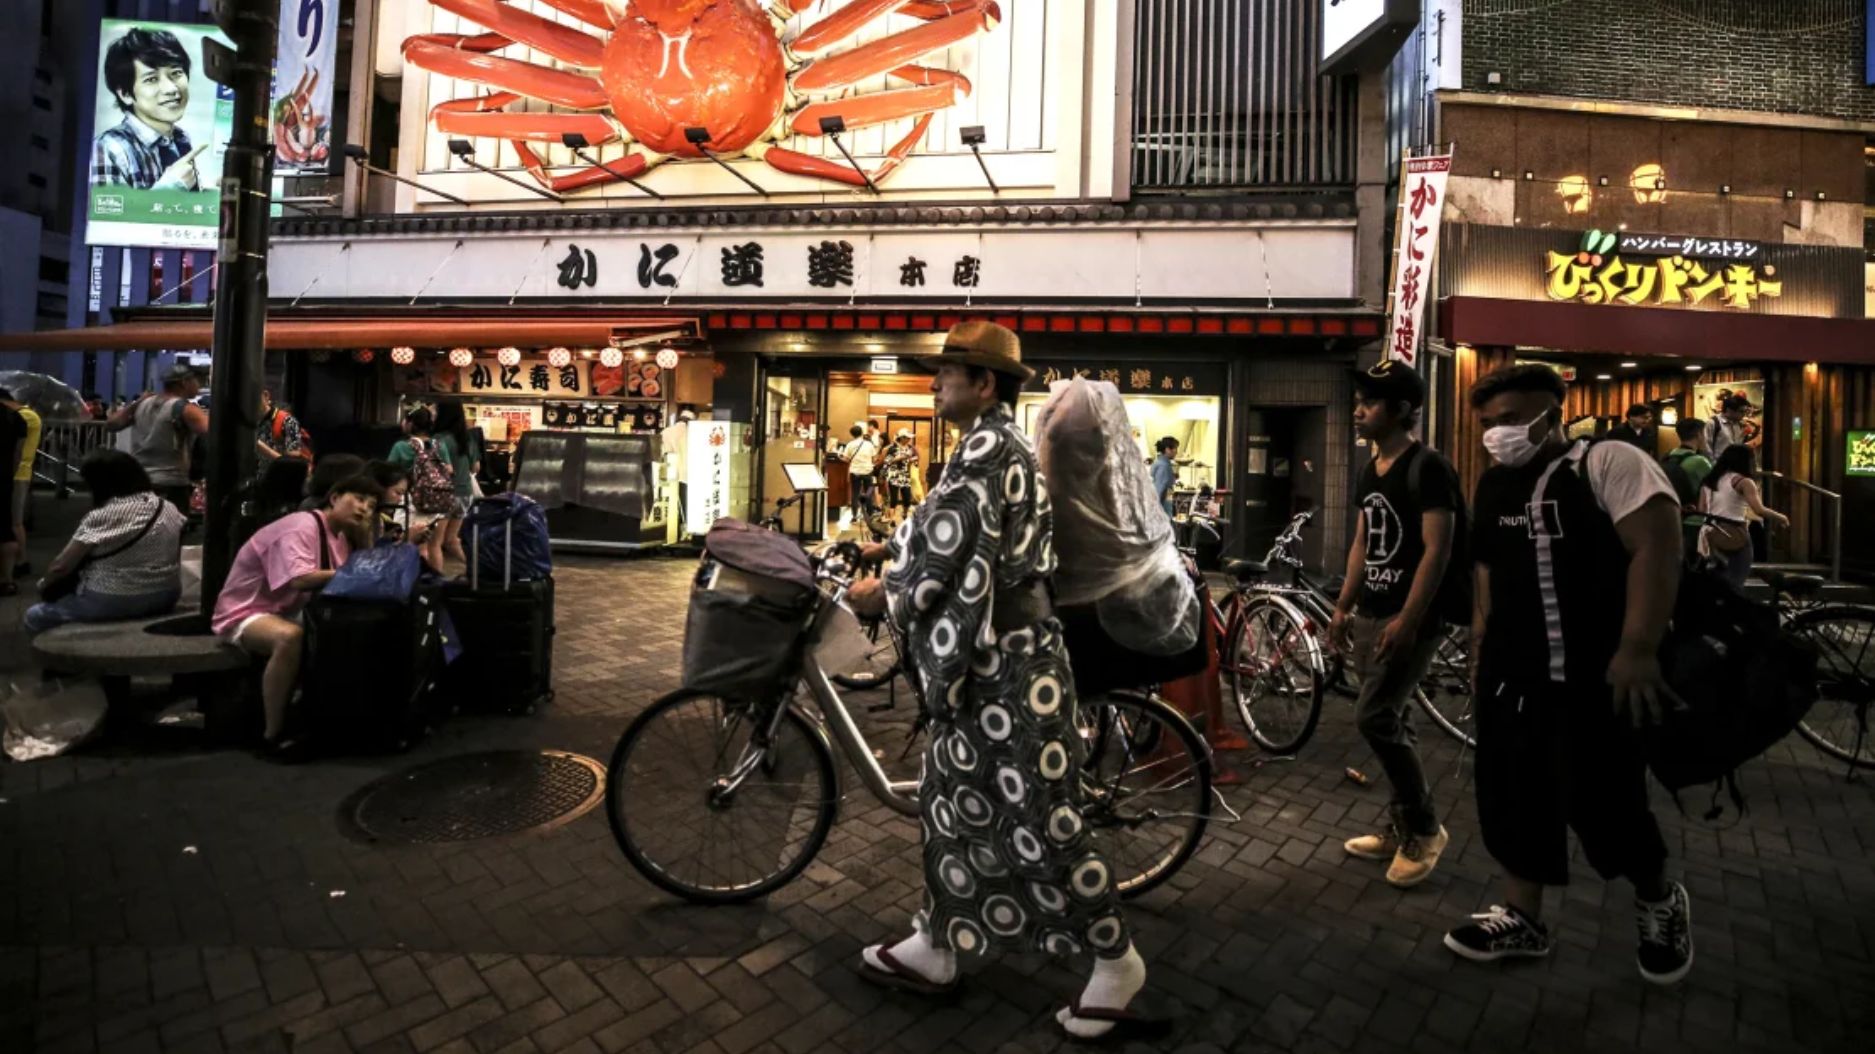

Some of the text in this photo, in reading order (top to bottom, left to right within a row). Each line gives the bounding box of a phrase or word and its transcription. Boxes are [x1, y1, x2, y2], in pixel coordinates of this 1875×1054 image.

[1622, 237, 1758, 256] ハンバーグレストラン
[899, 255, 980, 287] 本店
[1546, 250, 1783, 308] びっくりドンキー
[1365, 565, 1403, 583] DAY
